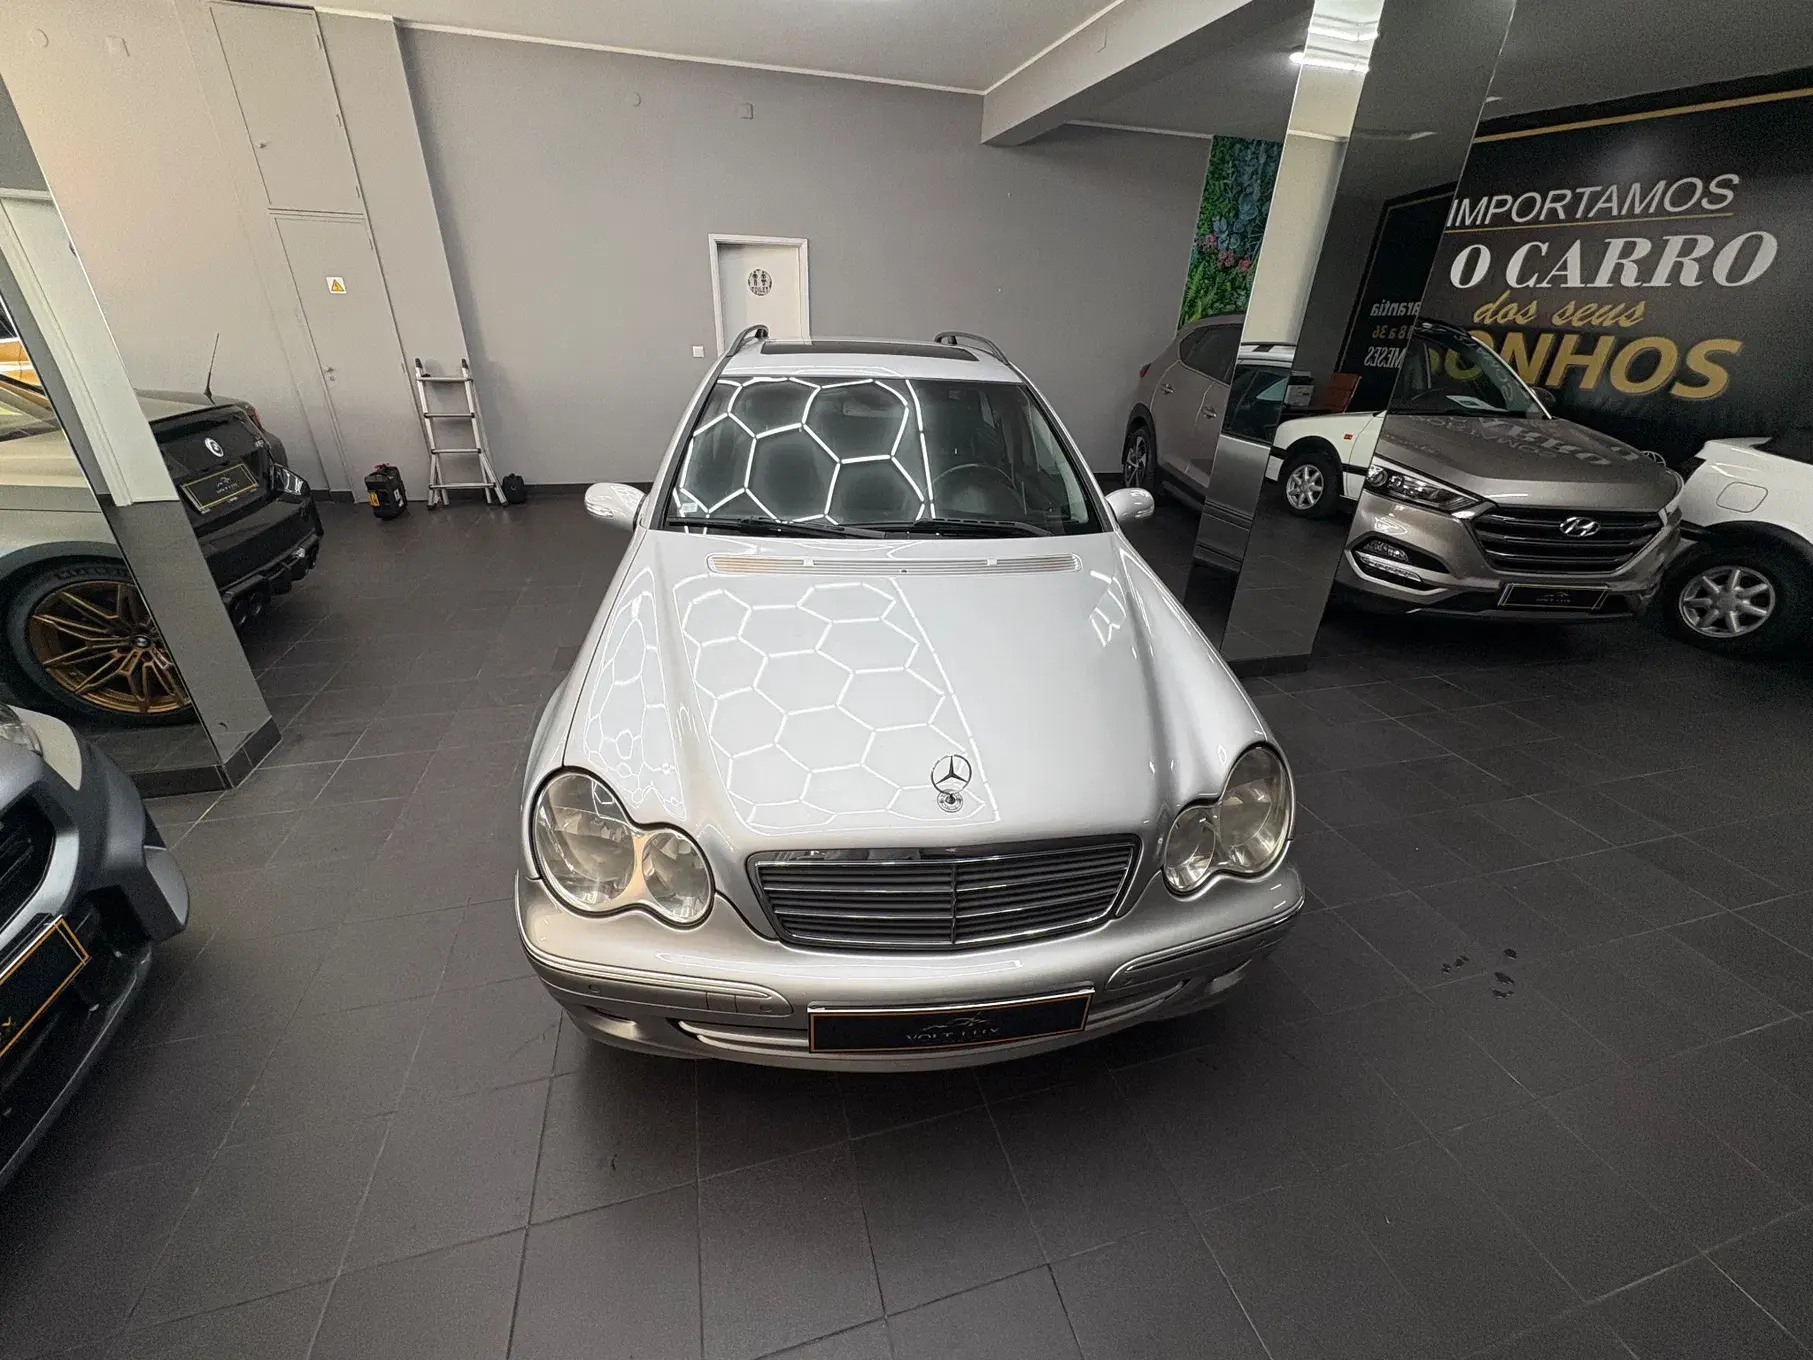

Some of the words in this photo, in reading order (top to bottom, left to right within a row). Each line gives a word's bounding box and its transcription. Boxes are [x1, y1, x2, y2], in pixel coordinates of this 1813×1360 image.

[1446, 173, 1741, 228] IMPORTAMOS
[1449, 243, 1492, 289] O
[1505, 230, 1779, 289] CARRO
[1472, 290, 1538, 325] dos
[1551, 299, 1649, 328] seus
